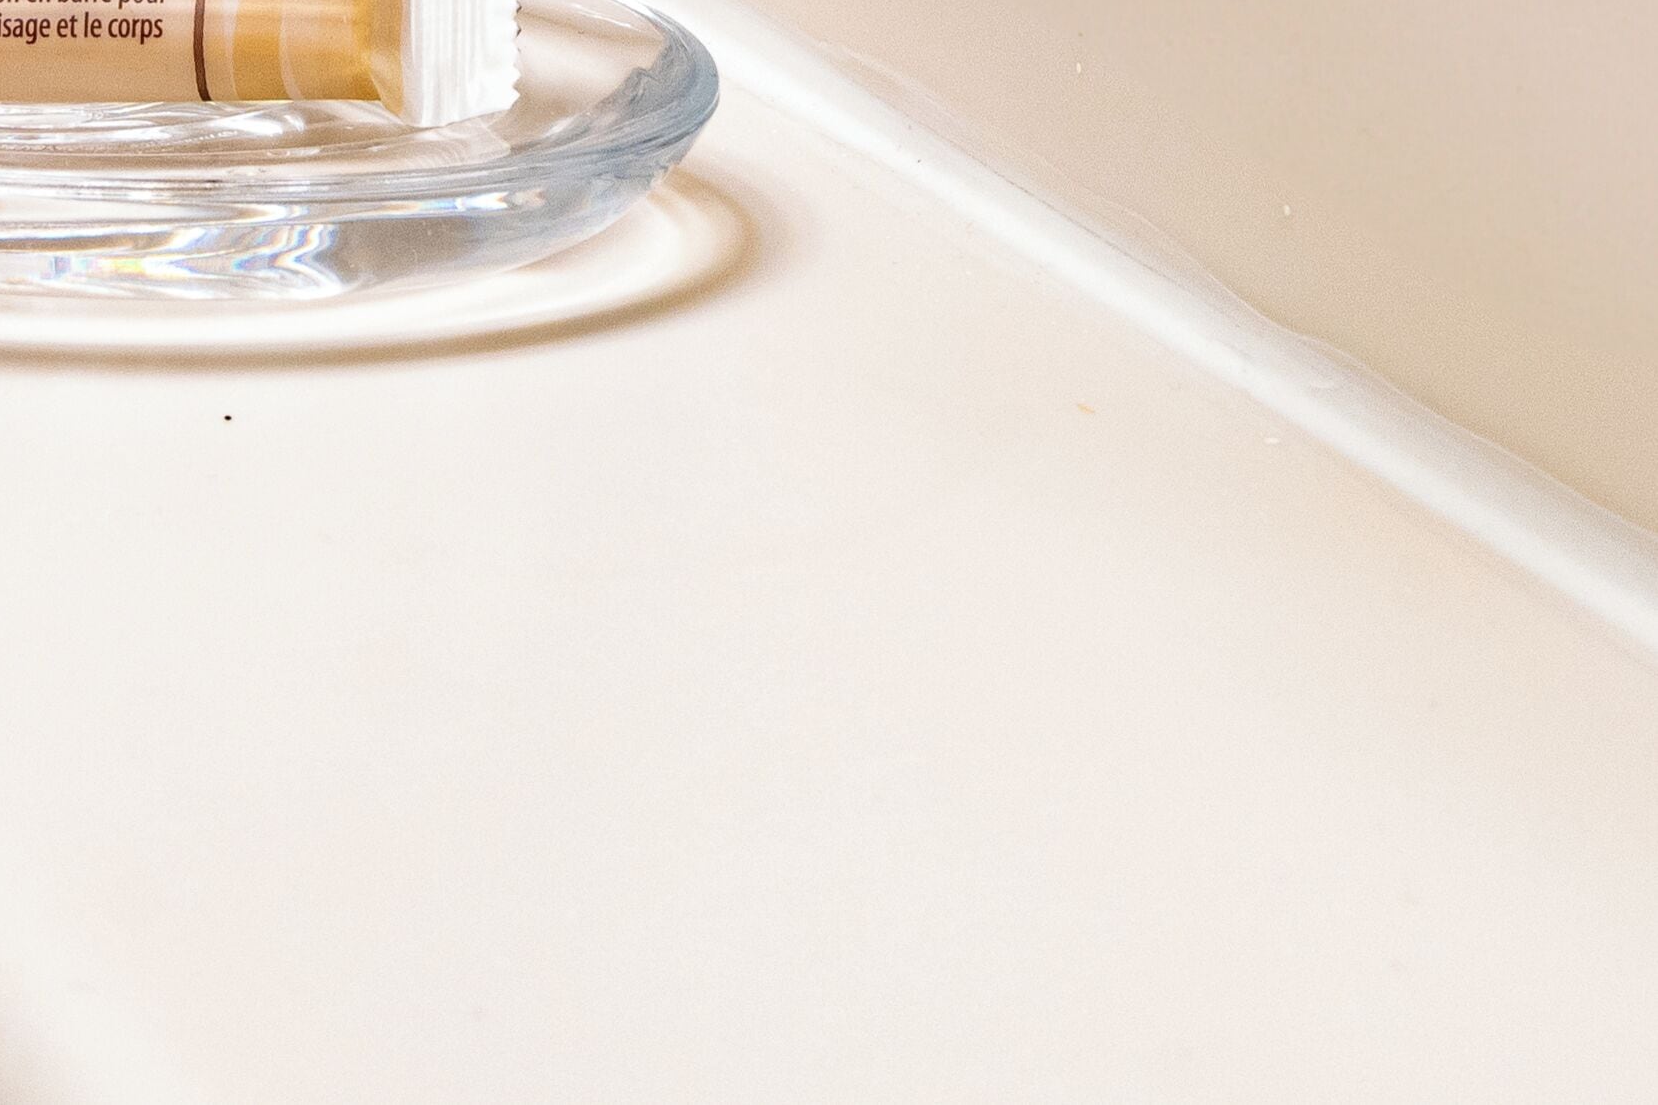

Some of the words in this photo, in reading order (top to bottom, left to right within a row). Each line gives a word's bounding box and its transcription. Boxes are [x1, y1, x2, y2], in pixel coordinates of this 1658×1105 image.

[56, 15, 78, 38] et
[84, 12, 103, 38] le
[108, 18, 164, 45] corps
